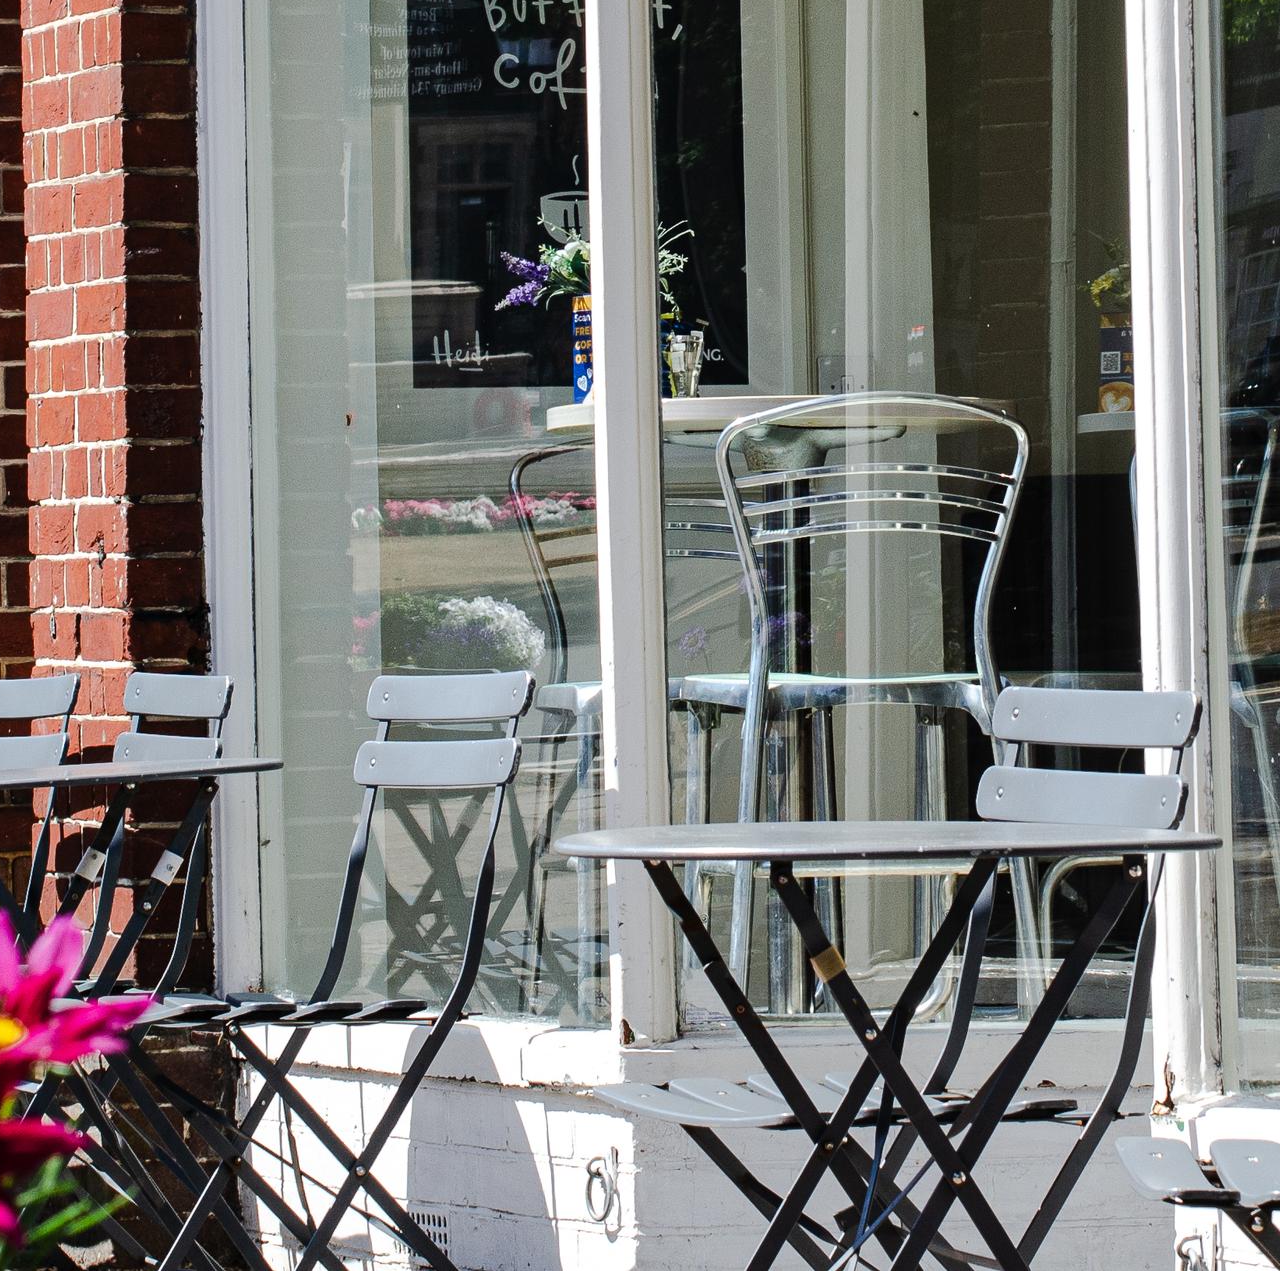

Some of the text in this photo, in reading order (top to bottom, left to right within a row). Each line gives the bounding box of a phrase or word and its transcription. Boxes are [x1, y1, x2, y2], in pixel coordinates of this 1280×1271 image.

[493, 38, 588, 110] Cof
[431, 329, 491, 368] Heidi
[575, 326, 592, 337] FRE
